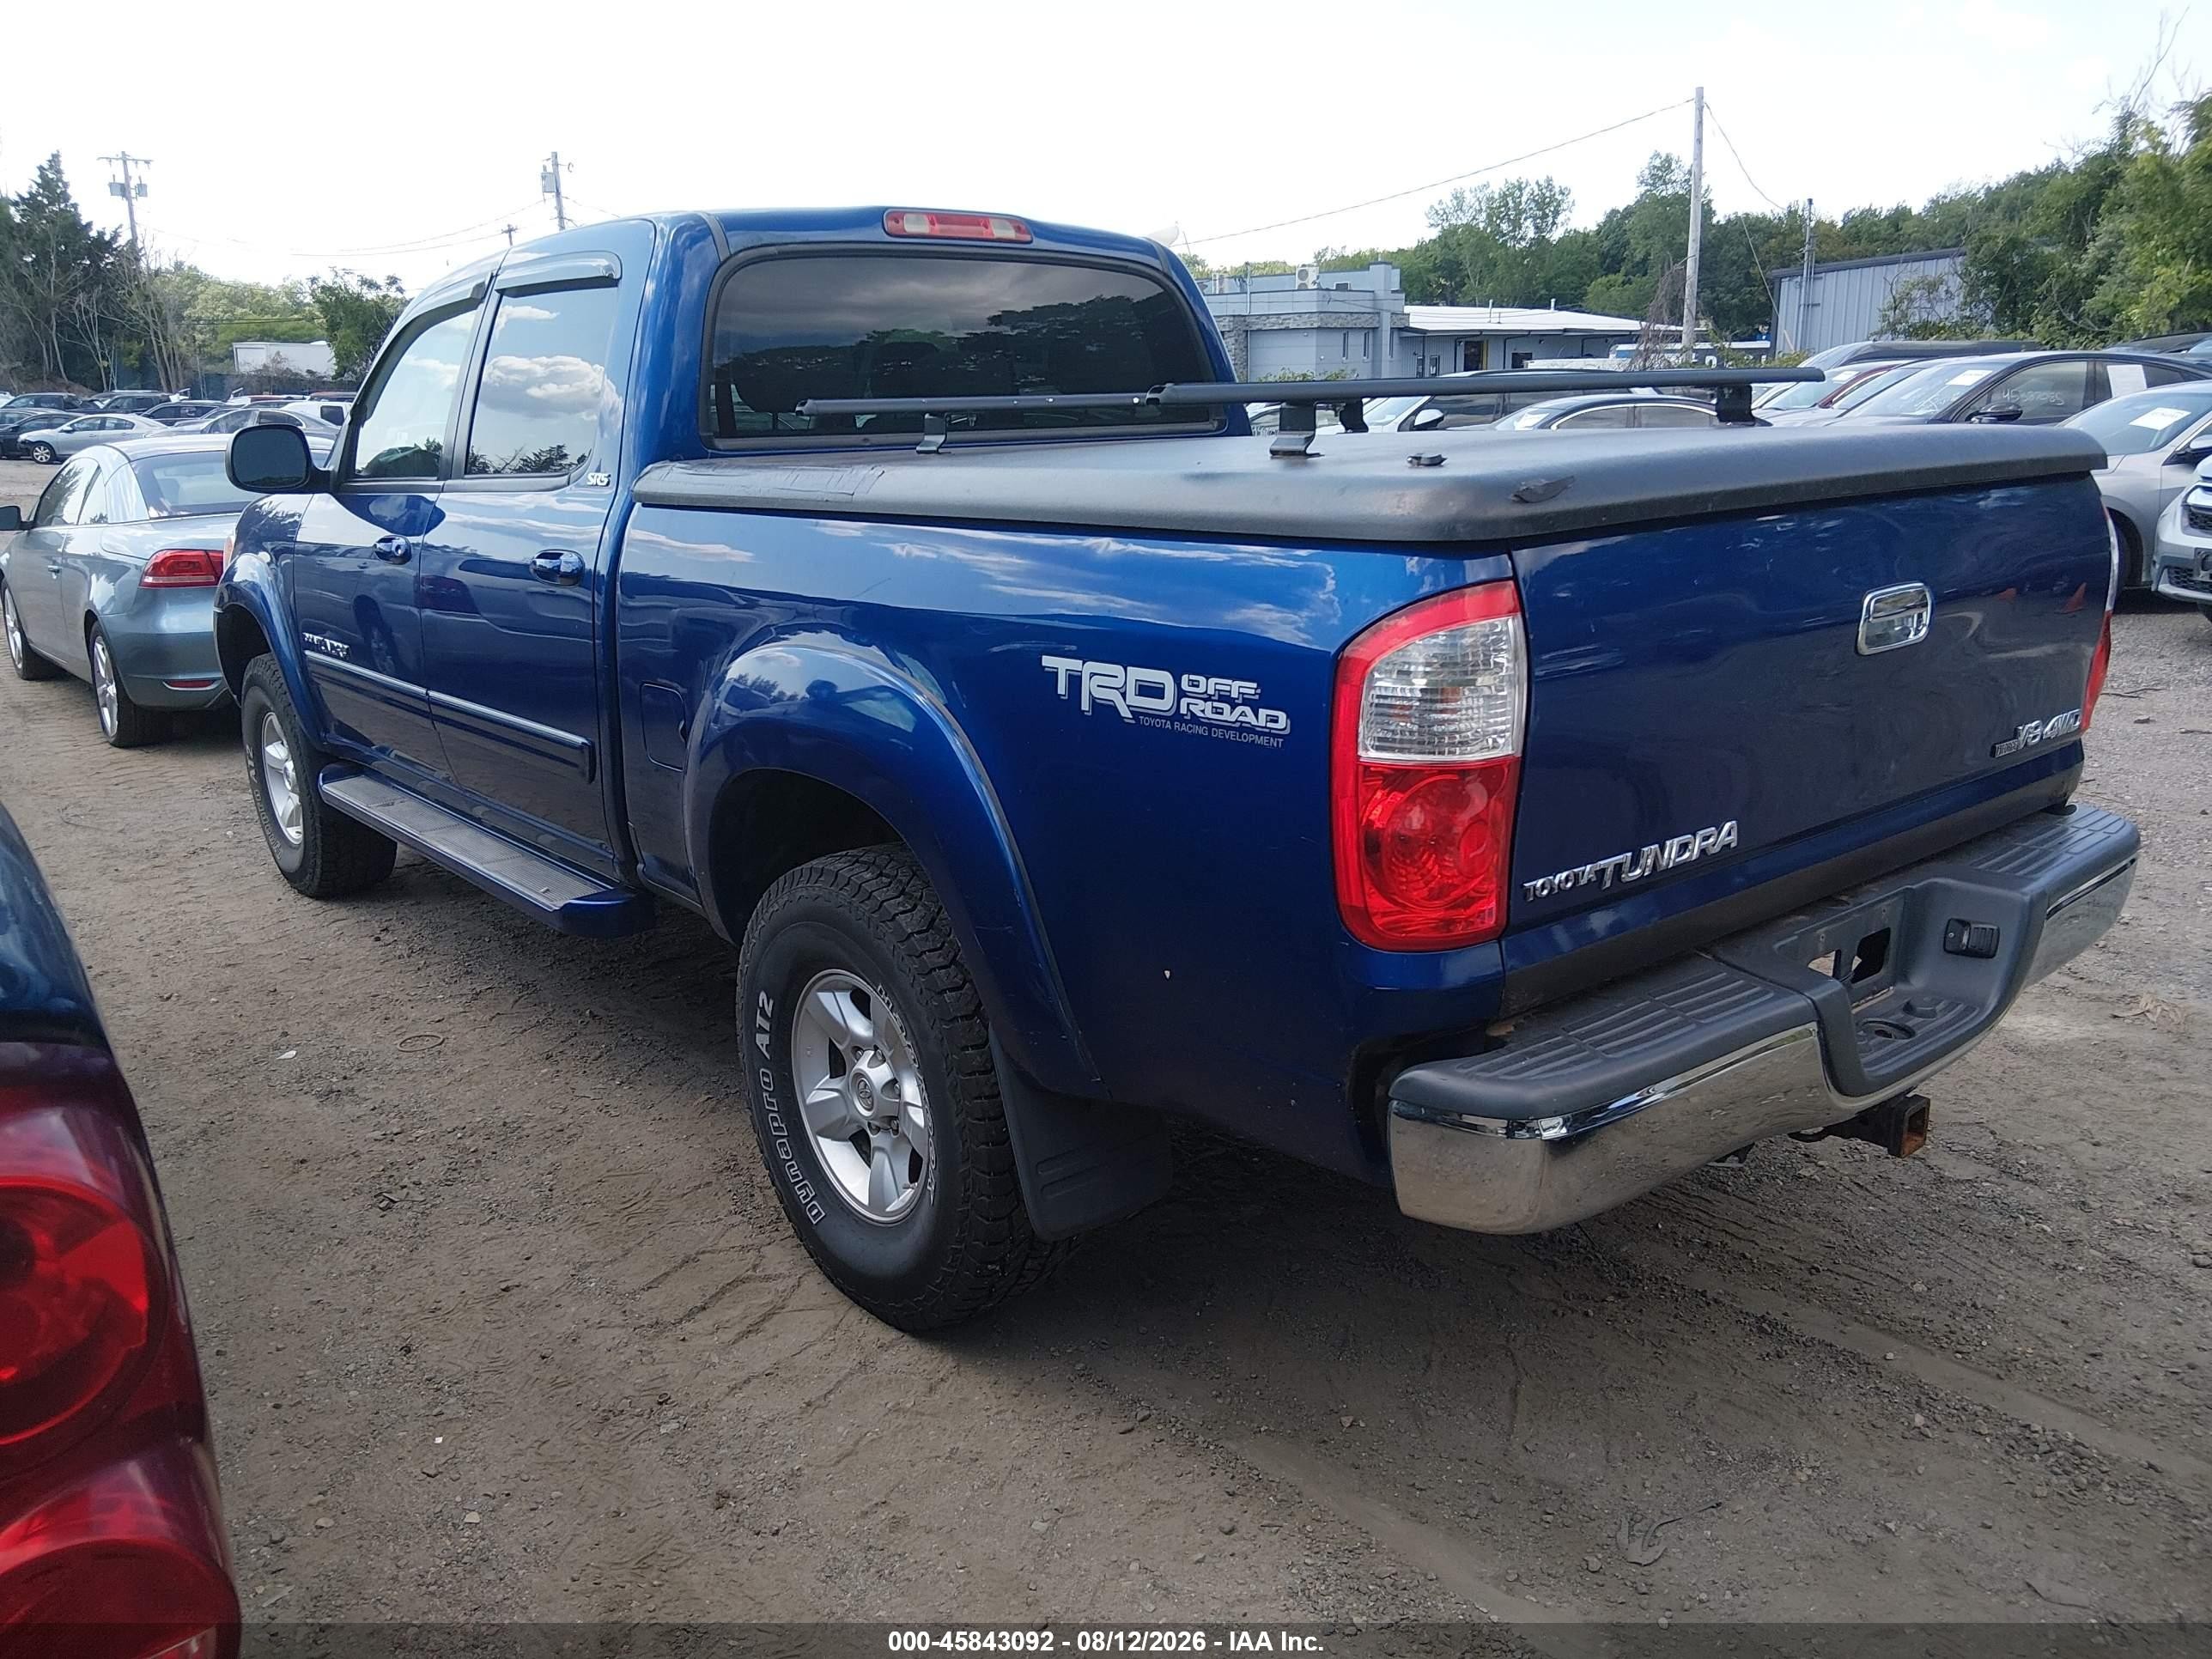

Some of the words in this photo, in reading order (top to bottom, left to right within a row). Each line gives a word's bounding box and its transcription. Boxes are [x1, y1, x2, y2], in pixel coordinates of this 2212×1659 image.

[587, 472, 611, 487] SR5
[1042, 655, 1177, 723] TRD
[1181, 674, 1261, 702] OFF
[1139, 715, 1172, 731] TOYOTA
[1174, 722, 1209, 737] RACING
[1211, 728, 1284, 749] DEVELOPMENT
[1180, 697, 1291, 735] ROAD
[2017, 720, 2042, 750] V8
[1523, 862, 1600, 902] TOYOTA
[1595, 819, 1738, 890] TUNDRA
[755, 990, 774, 1060] AT2
[758, 1068, 826, 1224] Dynapro
